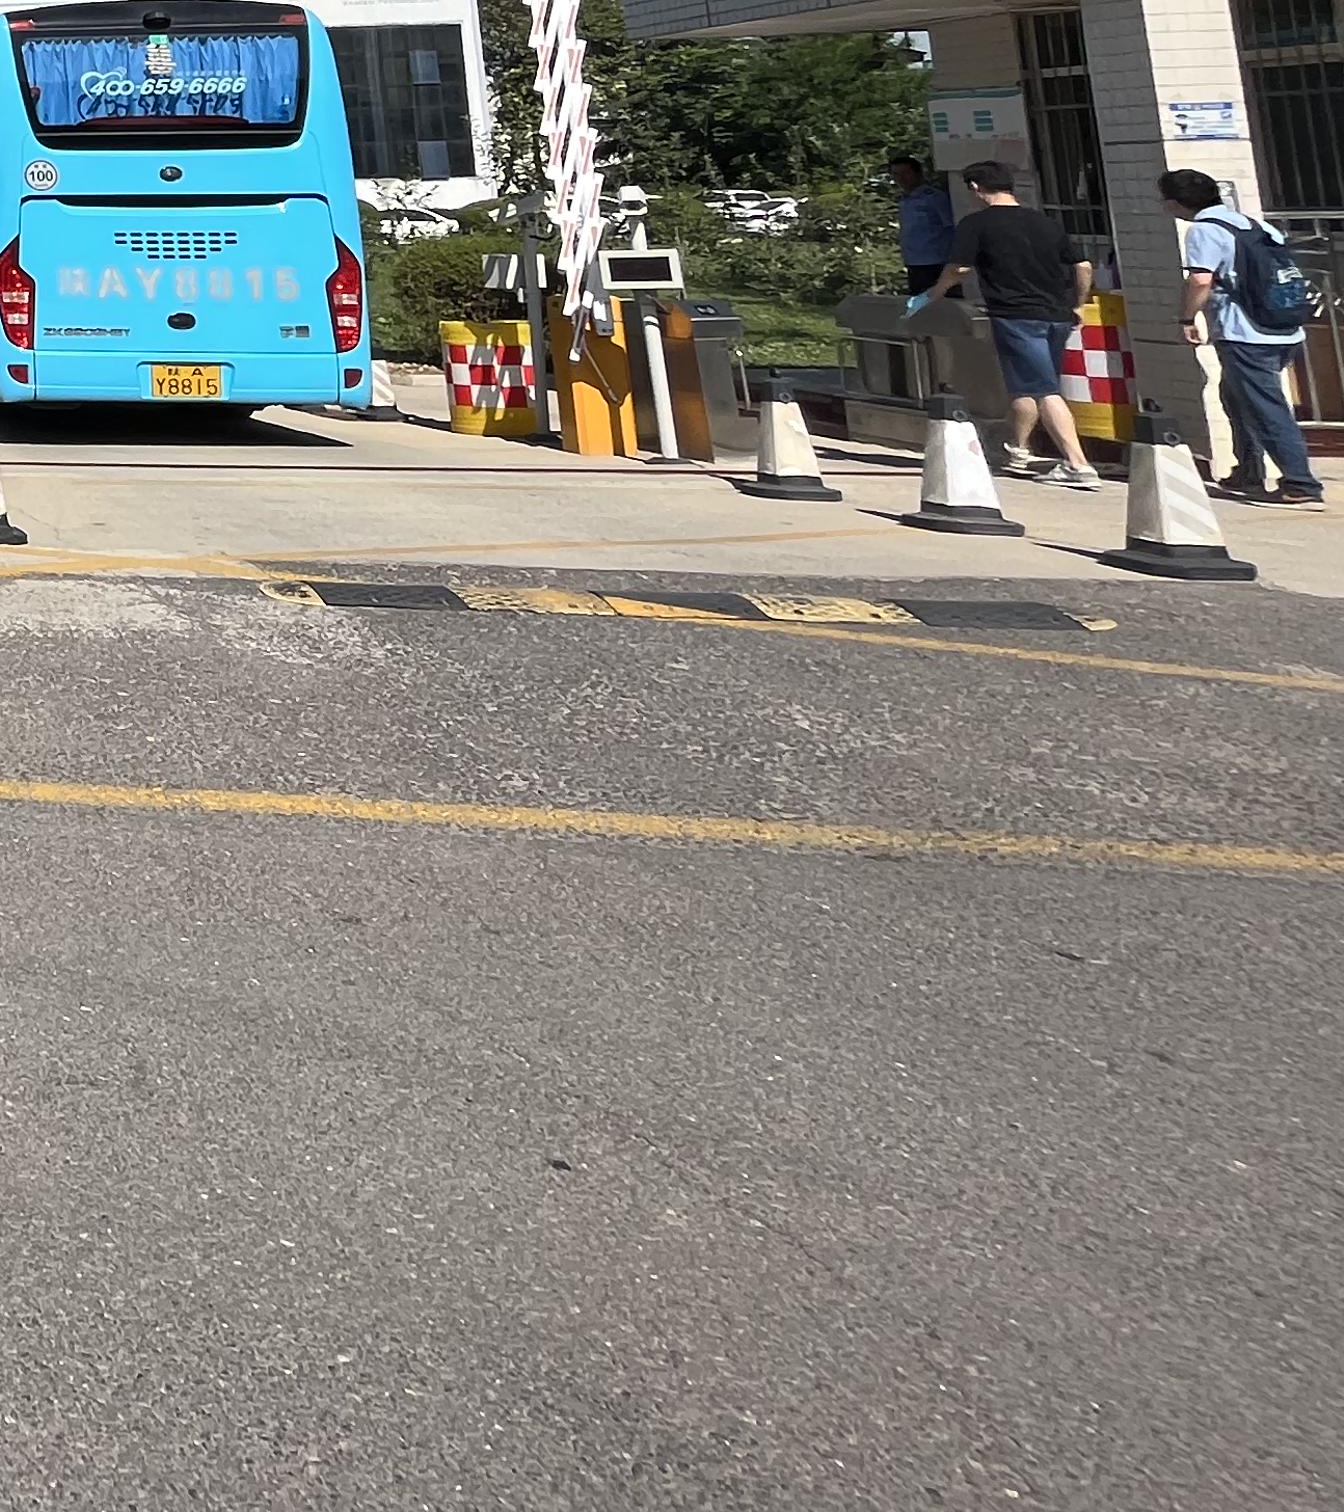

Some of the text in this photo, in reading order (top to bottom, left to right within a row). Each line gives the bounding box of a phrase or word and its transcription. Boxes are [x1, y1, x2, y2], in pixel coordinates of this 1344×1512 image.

[90, 77, 248, 96] 400-659-6666
[29, 169, 54, 182] 100
[156, 378, 219, 396] Y8815
